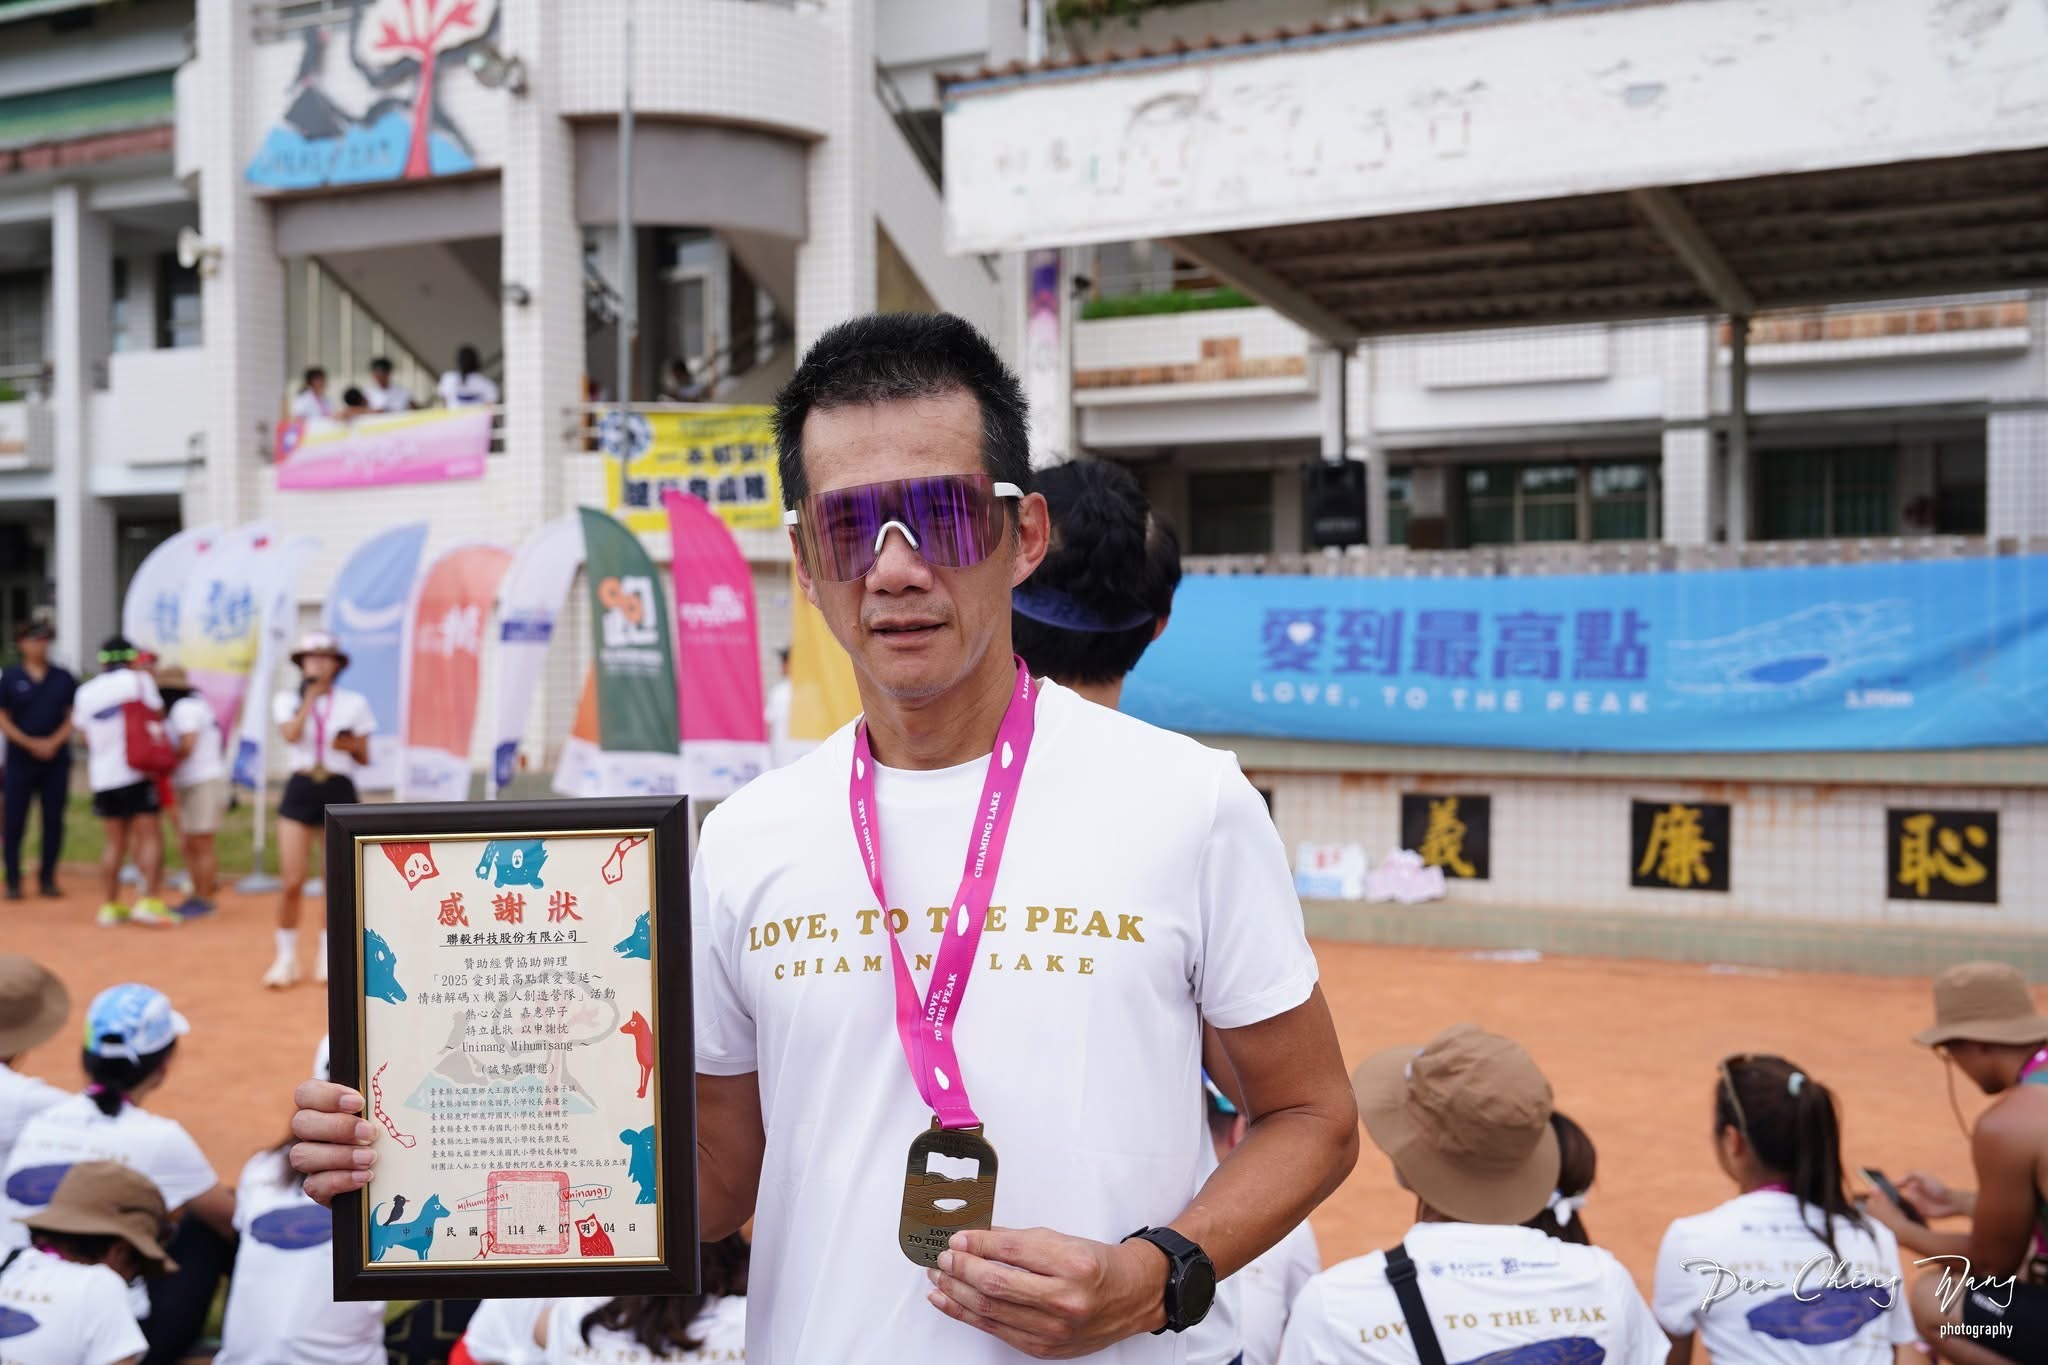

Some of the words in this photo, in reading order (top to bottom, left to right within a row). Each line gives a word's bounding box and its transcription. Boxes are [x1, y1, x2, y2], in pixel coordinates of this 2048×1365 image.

[1261, 606, 1651, 682] 愛到最高點
[1252, 681, 1360, 708] LOVE,
[1382, 686, 1429, 710] TO
[1451, 688, 1523, 713] THE
[1546, 691, 1650, 714] PEAK
[974, 822, 994, 879] CHIAMING
[987, 791, 1002, 821] LAKE
[1420, 797, 1477, 878] 義
[1637, 802, 1713, 888] 廉
[1896, 813, 1988, 897] 恥
[437, 890, 583, 928] 感謝狀
[446, 930, 578, 946] 聯毅科技股份有限公司
[749, 912, 839, 951] LOVE,
[856, 908, 909, 935] TO
[926, 905, 1007, 934] TE
[1025, 905, 1145, 943] PEAK
[464, 956, 568, 970] 贊助經費協助辦理
[774, 954, 934, 980] CHIAMN
[989, 953, 1095, 975] LAKE
[942, 973, 958, 1004] PEAK
[926, 990, 943, 1022] LOVE,
[935, 1006, 947, 1028] THE
[462, 1041, 506, 1054] Uninang
[511, 1040, 573, 1053] Mihumisang
[934, 1029, 944, 1042] TO
[508, 1225, 525, 1235] 114
[558, 1224, 570, 1233] 07
[604, 1223, 615, 1233] 04
[908, 1234, 922, 1244] TO
[925, 1237, 946, 1248] THE
[1359, 1321, 1408, 1344] LOV
[1444, 1312, 1479, 1331] TO
[1489, 1308, 1540, 1328] THE
[1550, 1305, 1608, 1324] PEAK
